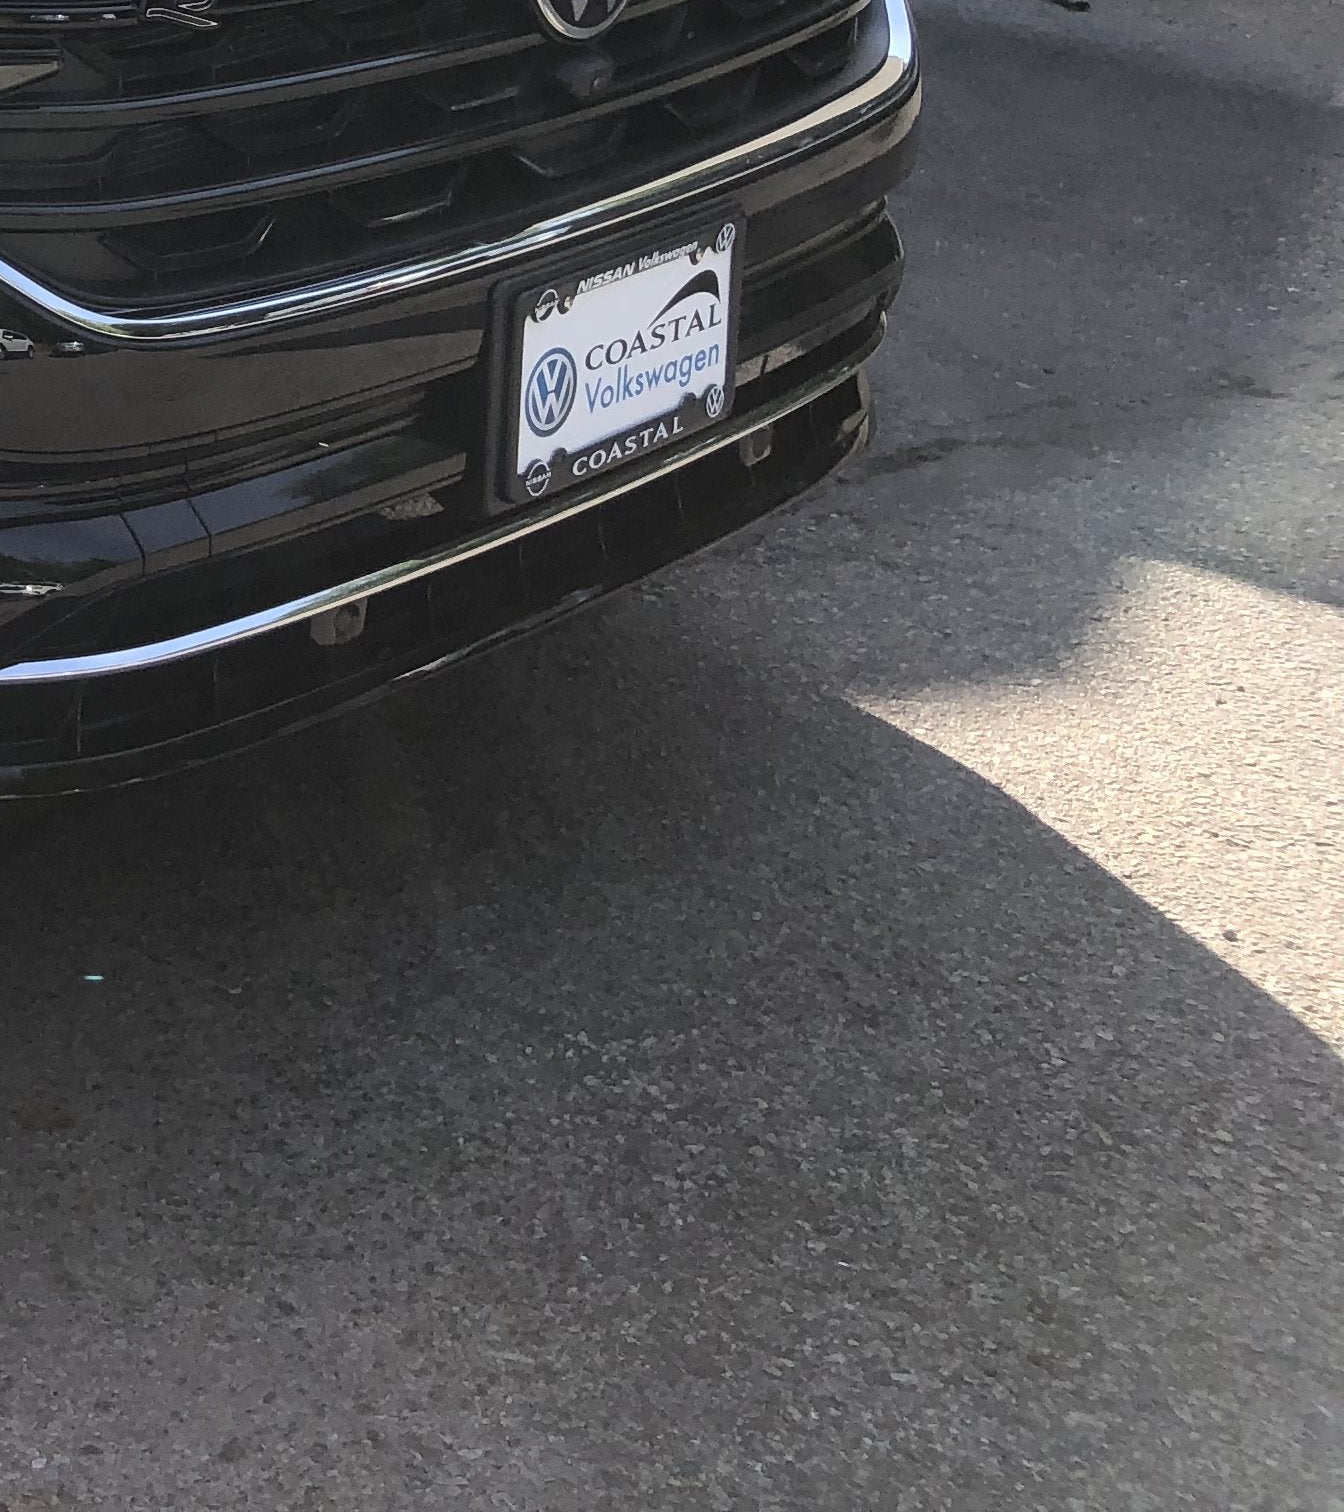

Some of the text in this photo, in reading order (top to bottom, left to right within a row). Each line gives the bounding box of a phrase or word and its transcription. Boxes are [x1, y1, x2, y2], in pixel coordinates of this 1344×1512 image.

[577, 240, 699, 295] NISSAN Volkswagen
[585, 303, 722, 370] COASTAL
[584, 343, 720, 414] Volkswagen
[572, 416, 684, 476] COASTAL
